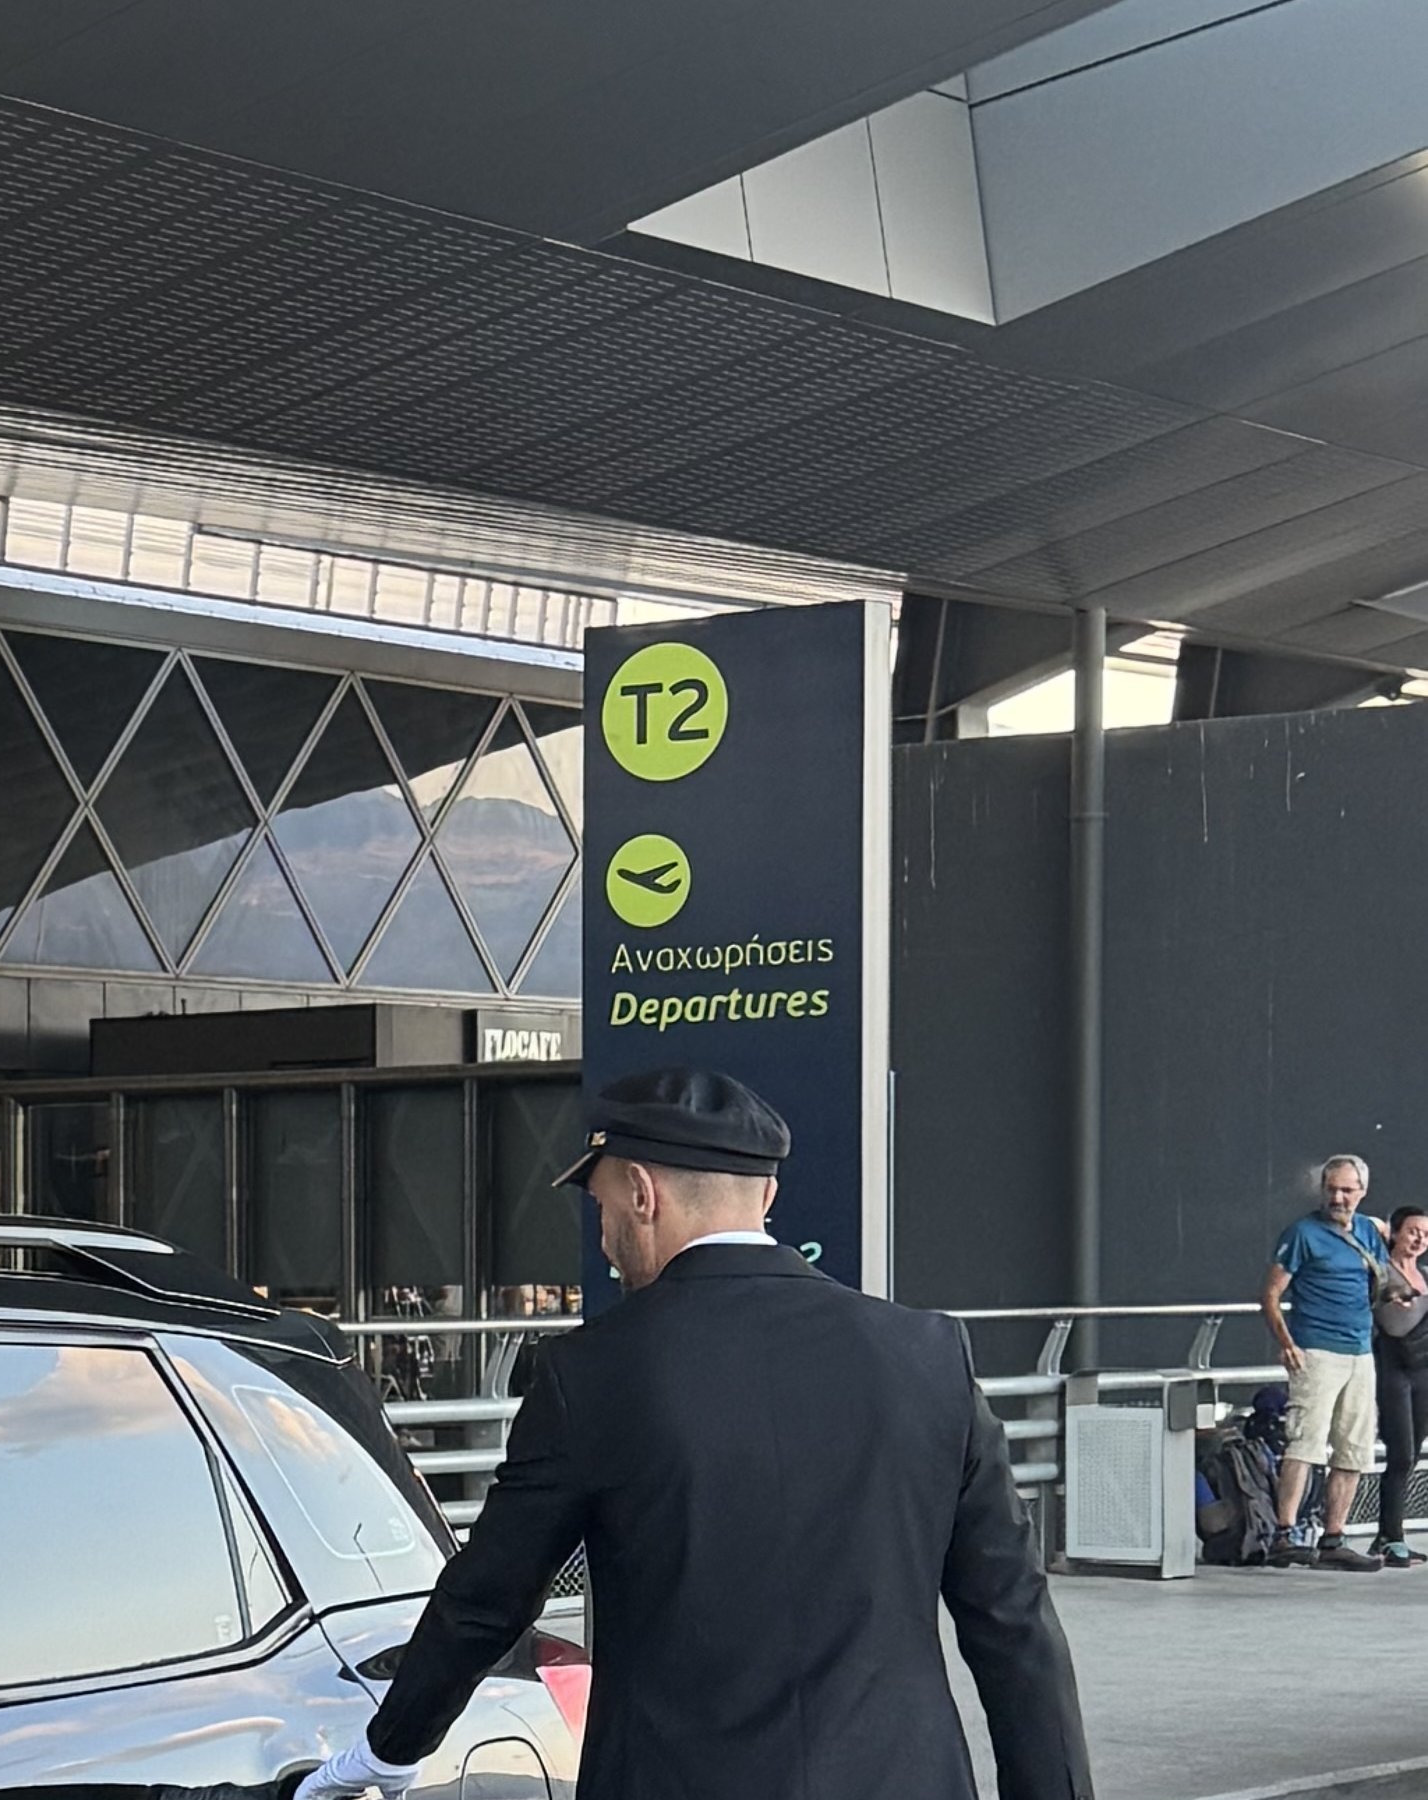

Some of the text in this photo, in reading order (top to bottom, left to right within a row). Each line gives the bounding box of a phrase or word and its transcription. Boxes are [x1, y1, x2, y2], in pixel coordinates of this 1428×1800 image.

[619, 678, 710, 746] T2
[611, 933, 834, 976] Αναχωρήσεις
[610, 988, 830, 1032] Departures
[484, 1028, 563, 1063] FLOCAFE
